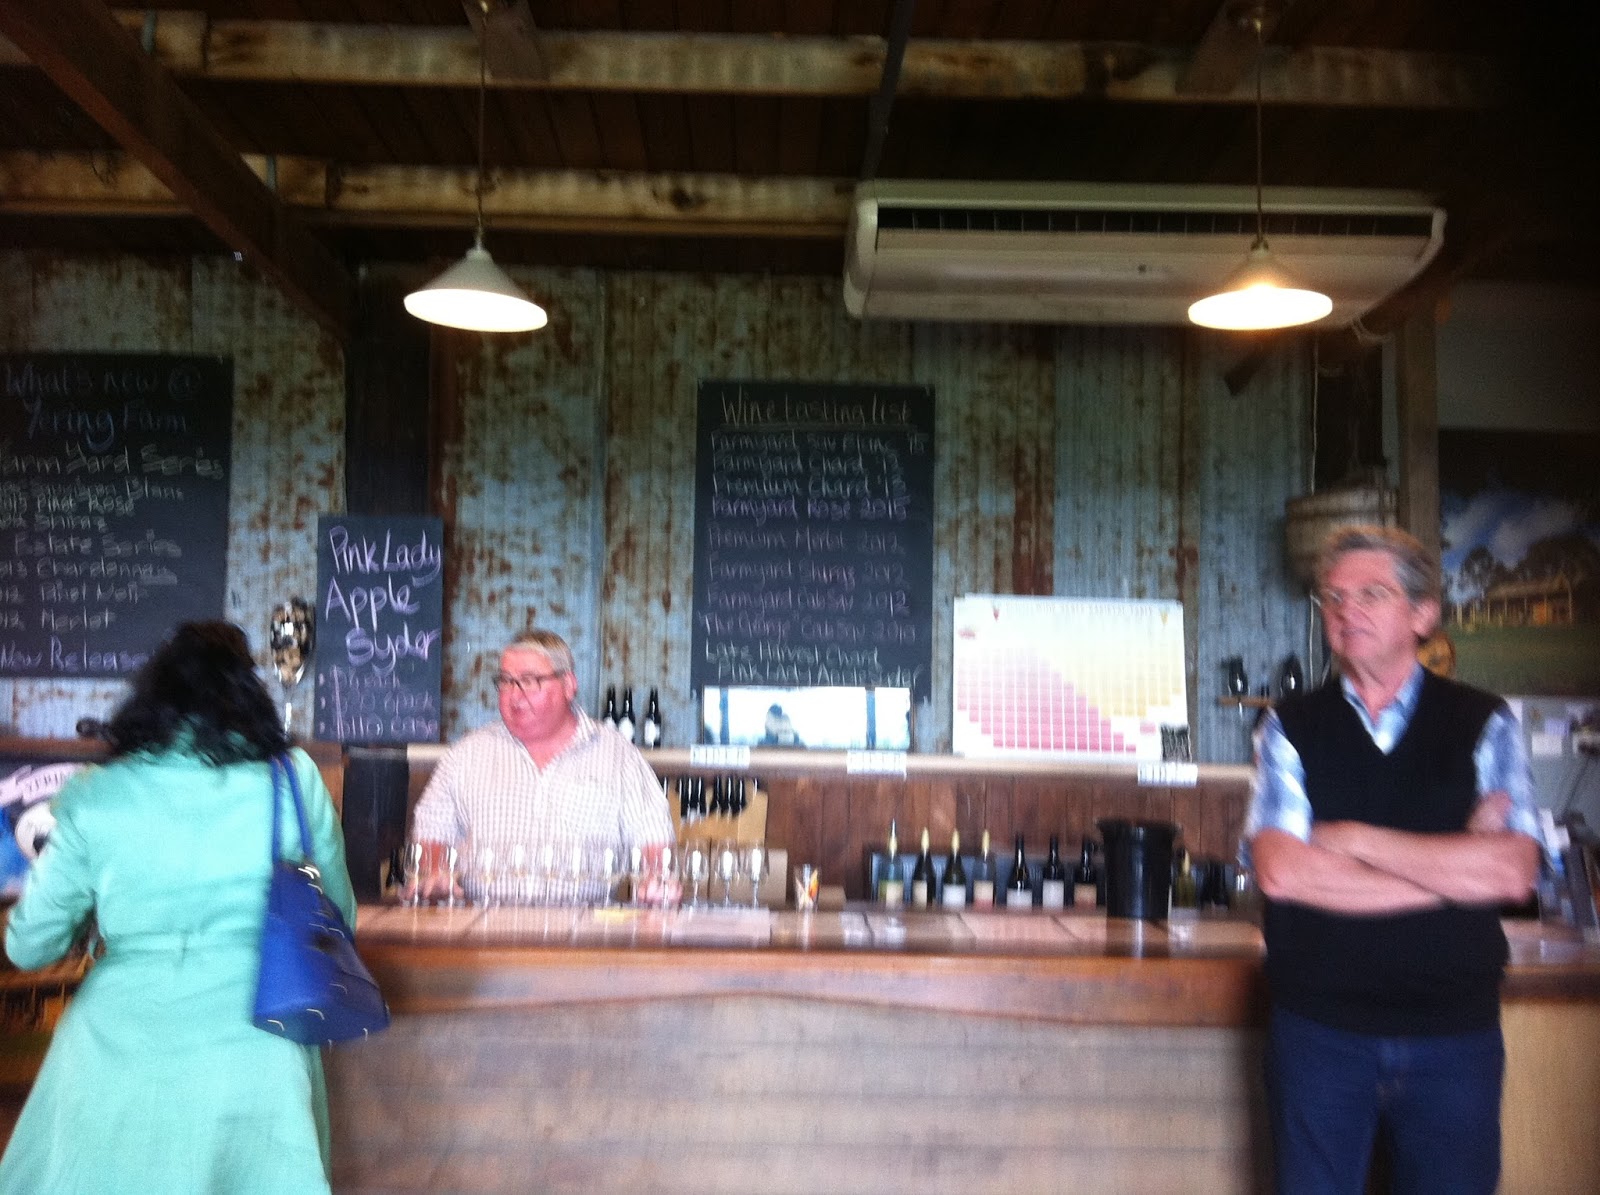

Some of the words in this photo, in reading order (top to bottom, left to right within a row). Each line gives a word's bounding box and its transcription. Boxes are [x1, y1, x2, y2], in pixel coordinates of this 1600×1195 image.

[720, 385, 776, 429] Wine
[2, 440, 131, 475] armyard
[328, 525, 380, 575] Pink
[382, 527, 441, 588] Lady
[325, 573, 421, 634] Apple
